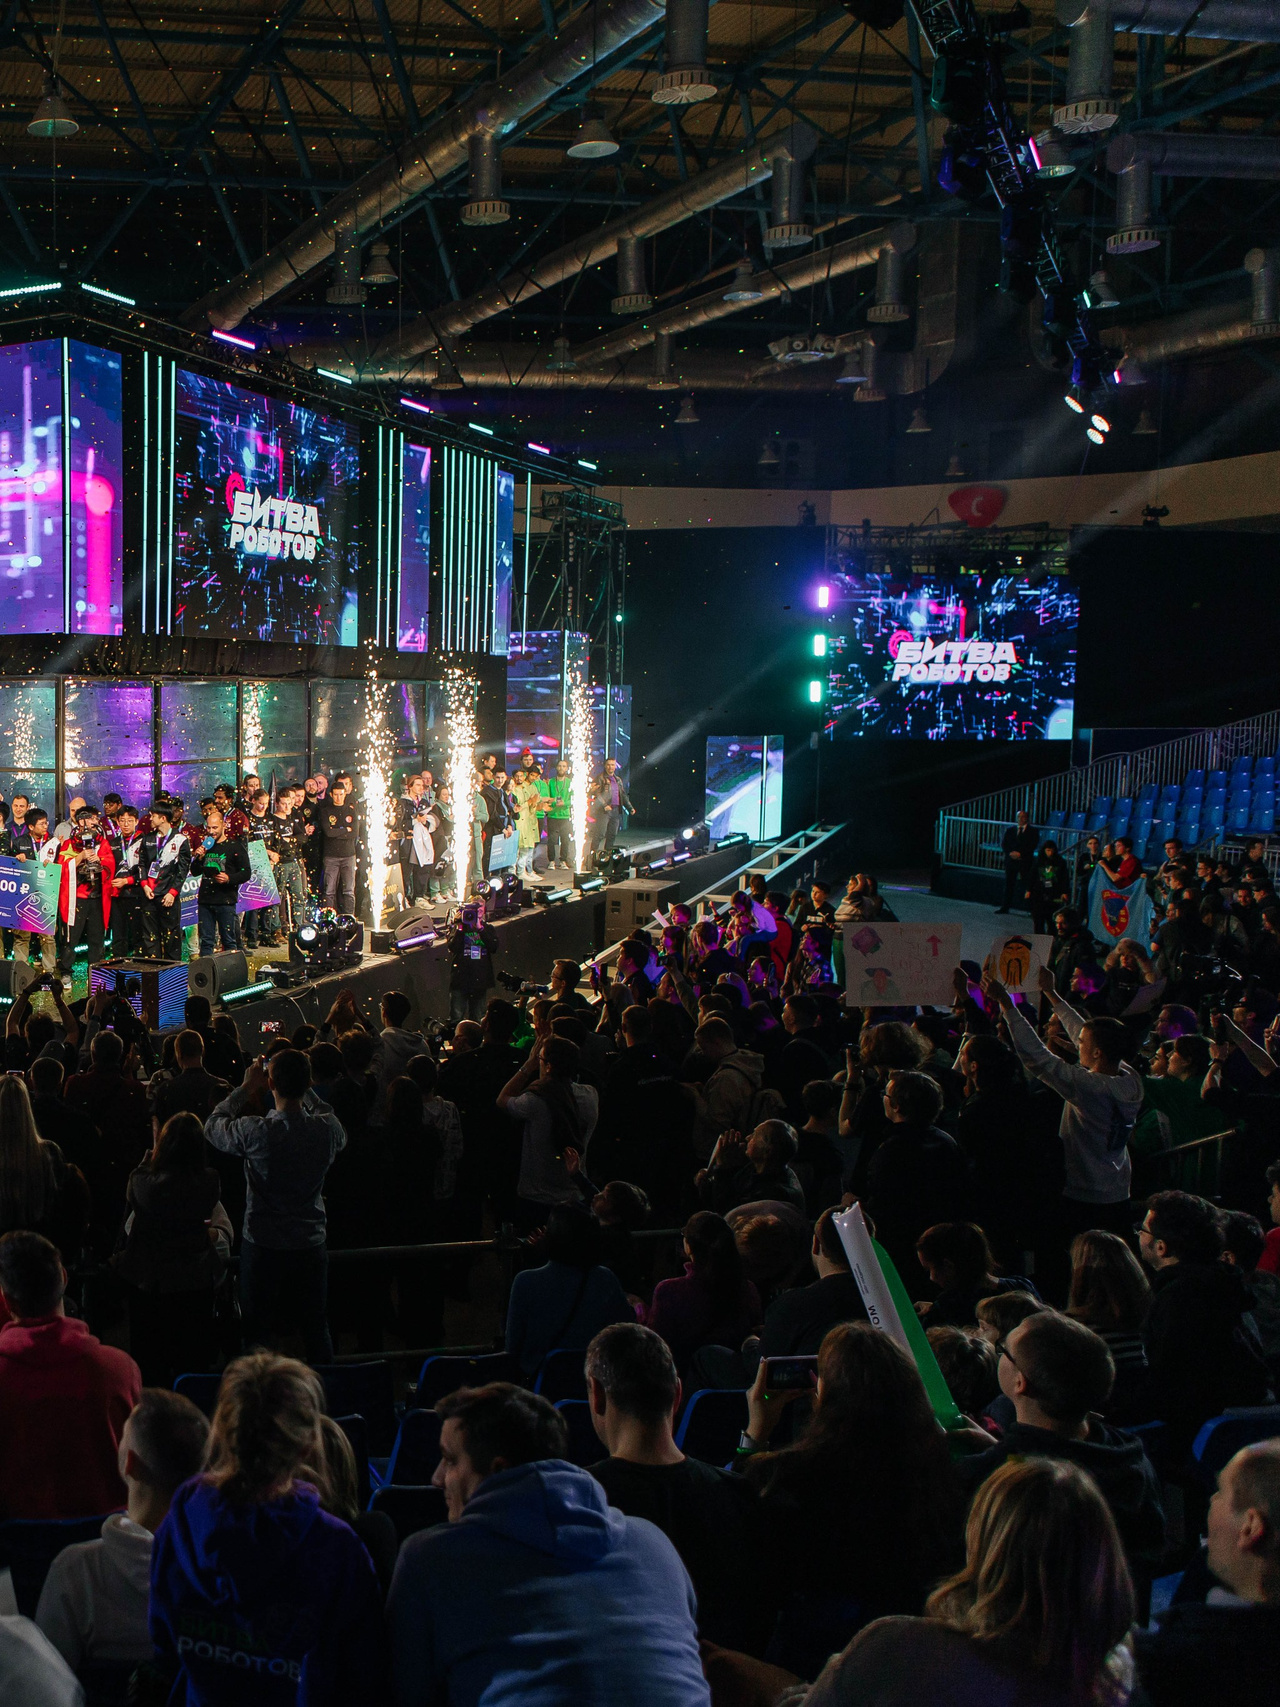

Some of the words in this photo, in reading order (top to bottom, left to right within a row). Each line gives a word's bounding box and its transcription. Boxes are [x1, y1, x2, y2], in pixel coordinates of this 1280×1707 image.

[230, 486, 320, 537] БИТВА
[229, 523, 317, 560] РОБОТОВ
[893, 637, 1017, 664] БИТВА
[891, 663, 1013, 683] РОБОТОВ
[177, 1635, 304, 1682] РОБОТОВ
